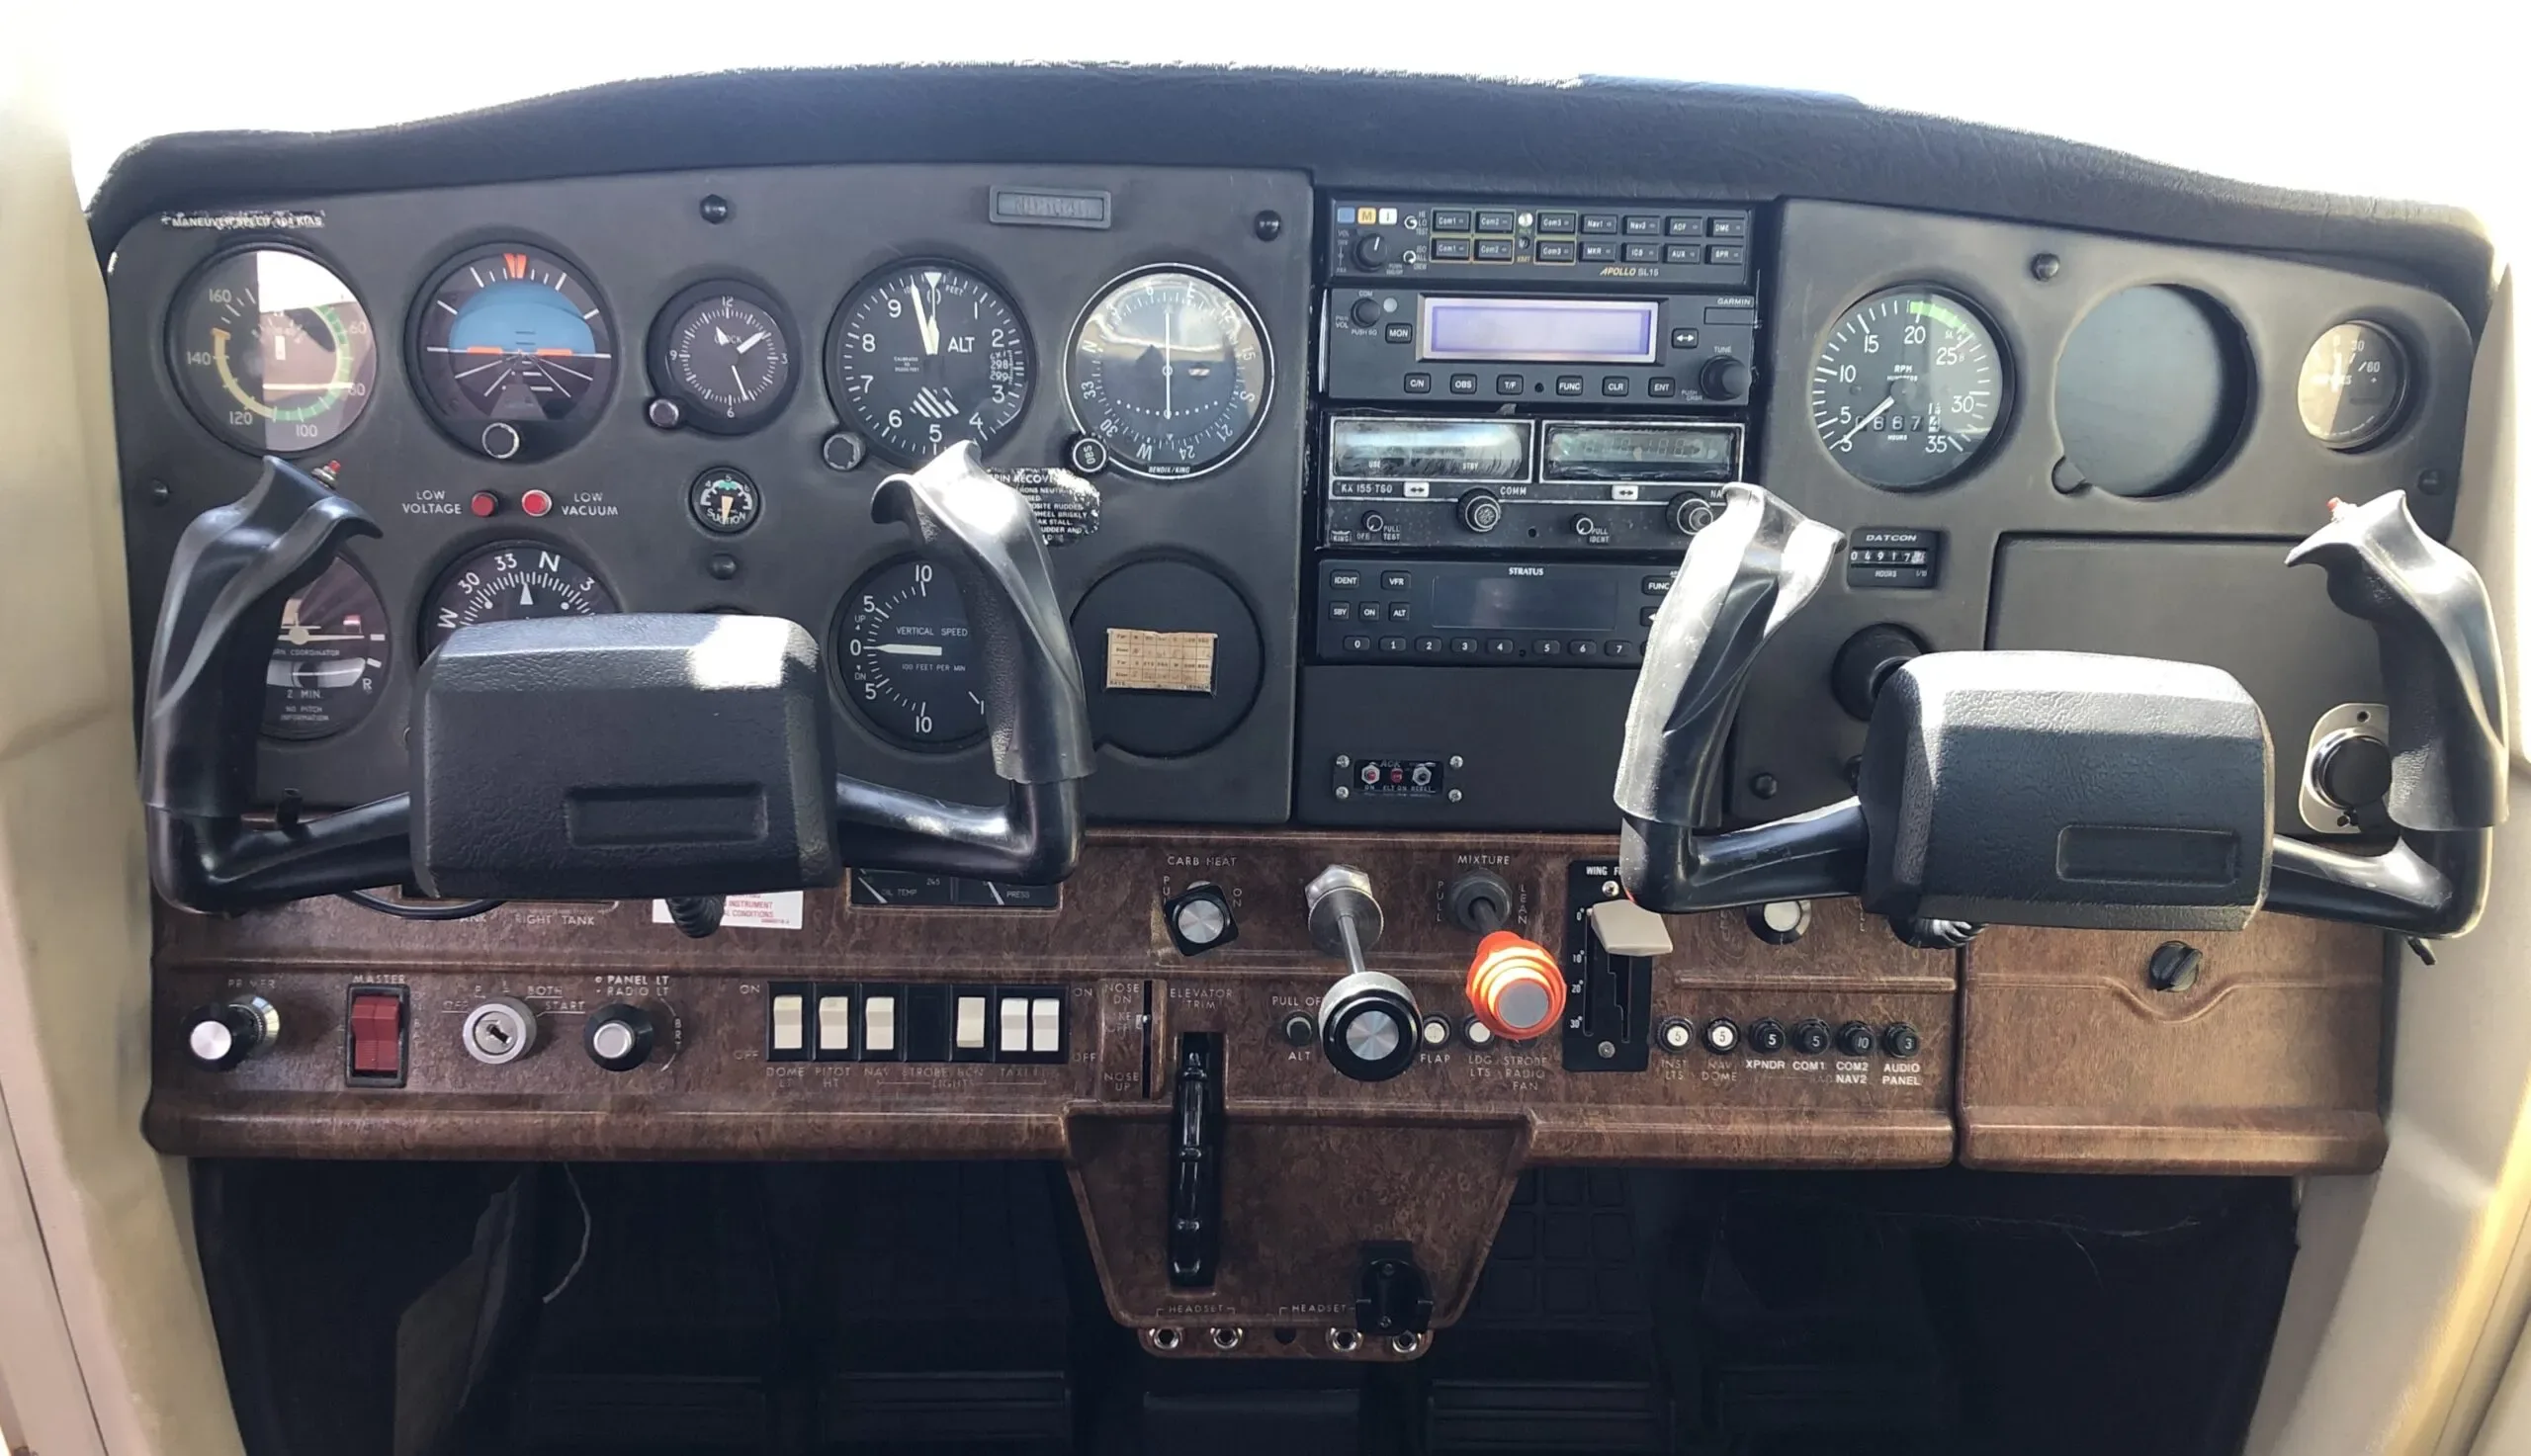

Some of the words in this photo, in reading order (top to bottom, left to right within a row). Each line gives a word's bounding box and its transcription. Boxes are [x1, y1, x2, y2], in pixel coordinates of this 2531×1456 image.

[1439, 217, 1457, 226] Com1
[1481, 217, 1499, 226] Com2
[1542, 217, 1562, 227] Com3
[1587, 219, 1604, 228] Nav1
[1629, 221, 1646, 230] Nav2
[1673, 221, 1687, 231] ADF
[1715, 223, 1730, 232] DME
[1439, 244, 1456, 253] Com1
[1481, 245, 1499, 254] Com2
[1542, 247, 1562, 256] Com3
[1671, 249, 1687, 258] AUX
[1600, 267, 1637, 277] APOLLO
[209, 289, 231, 302] 160
[722, 296, 734, 307] 12
[1716, 297, 1751, 306] GARMIN
[888, 299, 902, 318] 9
[349, 322, 367, 334] 60
[1388, 328, 1409, 338] MON
[991, 328, 1004, 347] 2
[1903, 324, 1927, 345] 20
[862, 333, 876, 352] 8
[947, 336, 976, 353] ALT
[1082, 339, 1097, 354] N
[1864, 334, 1879, 354] 15
[187, 351, 211, 366] 140
[1241, 346, 1257, 361] 15
[1936, 346, 1959, 366] 25
[1839, 364, 1858, 384] 10
[1894, 364, 1913, 374] RPM
[860, 375, 874, 393] 7
[1410, 380, 1426, 388] C/N
[1455, 380, 1472, 389] OBS
[1504, 382, 1517, 390] T/F
[1558, 382, 1582, 392] FUNC
[1608, 384, 1625, 392] CLR
[1653, 384, 1670, 392] ENT
[992, 385, 1005, 403] 3
[1081, 380, 1096, 400] 33
[1239, 390, 1256, 402] S
[1951, 395, 1975, 414] 30
[229, 411, 253, 425] 120
[888, 409, 903, 428] 6
[969, 411, 984, 430] 4
[1840, 405, 1852, 425] 5
[296, 424, 318, 437] 100
[928, 424, 942, 442] 5
[1099, 418, 1118, 438] 30
[1216, 423, 1234, 443] 21
[1924, 435, 1948, 454] 35
[1136, 442, 1153, 462] W
[1178, 444, 1196, 461] 24
[1148, 466, 1191, 474] BENDIX/KING
[1341, 484, 1353, 494] KX
[1356, 484, 1371, 494] 155
[1499, 486, 1527, 496] COMM
[416, 490, 446, 500] LOW
[573, 492, 603, 502] LOW
[402, 503, 462, 514] VOLTAGE
[562, 505, 618, 516] VACUUM
[1866, 534, 1918, 543] DATCON
[494, 553, 517, 571] 33
[539, 551, 561, 572] N
[916, 564, 932, 582] 10
[1508, 567, 1544, 576] STRATUS
[458, 572, 480, 594] 30
[579, 576, 595, 591] 3
[1335, 576, 1358, 585] IDENT
[1388, 577, 1404, 586] VFR
[1648, 581, 1671, 591] FUNC
[863, 595, 875, 613] 5
[1333, 607, 1348, 617] SBY
[1363, 608, 1376, 617] ON
[1392, 609, 1406, 618] ALT
[854, 614, 866, 623] UP
[896, 626, 934, 636] VERTICAL
[941, 628, 968, 638] SPEED
[849, 639, 862, 656] 0
[854, 672, 866, 681] DN
[865, 683, 877, 700] 5
[916, 716, 932, 733] 10
[1167, 856, 1199, 866] CARB
[1206, 856, 1238, 867] HEAT
[1457, 854, 1511, 866] MIXTURE
[1586, 866, 1608, 876] WING
[897, 889, 917, 898] TEMP
[1005, 890, 1030, 899] PRESS
[1518, 885, 1527, 925] LEAN
[562, 915, 595, 926] TANK
[352, 974, 406, 985] MASTER
[607, 975, 649, 986] PANEL
[656, 976, 670, 986] LT
[526, 985, 564, 996] BOTH
[739, 984, 761, 994] ON
[1074, 987, 1093, 997] ON
[1104, 983, 1139, 994] NOSE
[1170, 987, 1233, 998] ELEVATOR
[1113, 994, 1132, 1005] DN
[1184, 998, 1216, 1010] TRIM
[1271, 995, 1299, 1006] PULL
[545, 1000, 586, 1012] START
[1858, 1037, 1870, 1050] 10
[732, 1050, 759, 1060] OFF
[1074, 1052, 1096, 1063] OFF
[1287, 1052, 1311, 1062] ALT
[1420, 1054, 1451, 1065] FLAP
[1468, 1056, 1493, 1066] LDG
[1661, 1059, 1689, 1069] INST
[1707, 1060, 1732, 1070] NAV
[1745, 1060, 1786, 1070] XPNDR
[1791, 1061, 1827, 1071] COM1
[1835, 1061, 1869, 1072] COM2
[766, 1067, 806, 1077] DOME
[815, 1067, 850, 1076] PITOT
[864, 1068, 890, 1077] NAV
[902, 1068, 948, 1077] STROBE
[1001, 1068, 1028, 1077] TAXI
[1469, 1068, 1491, 1077] LTS
[1505, 1068, 1546, 1079] RADIO
[1882, 1064, 1922, 1073] AUDIO
[1103, 1071, 1139, 1082] NOSE
[1701, 1071, 1738, 1081] DOME
[1835, 1073, 1869, 1085] NAV2
[1882, 1075, 1922, 1086] PANEL
[1115, 1082, 1131, 1092] UP
[1513, 1081, 1538, 1091] FAN
[1169, 1303, 1224, 1314] HEADSET
[1291, 1303, 1346, 1314] HEADSET
